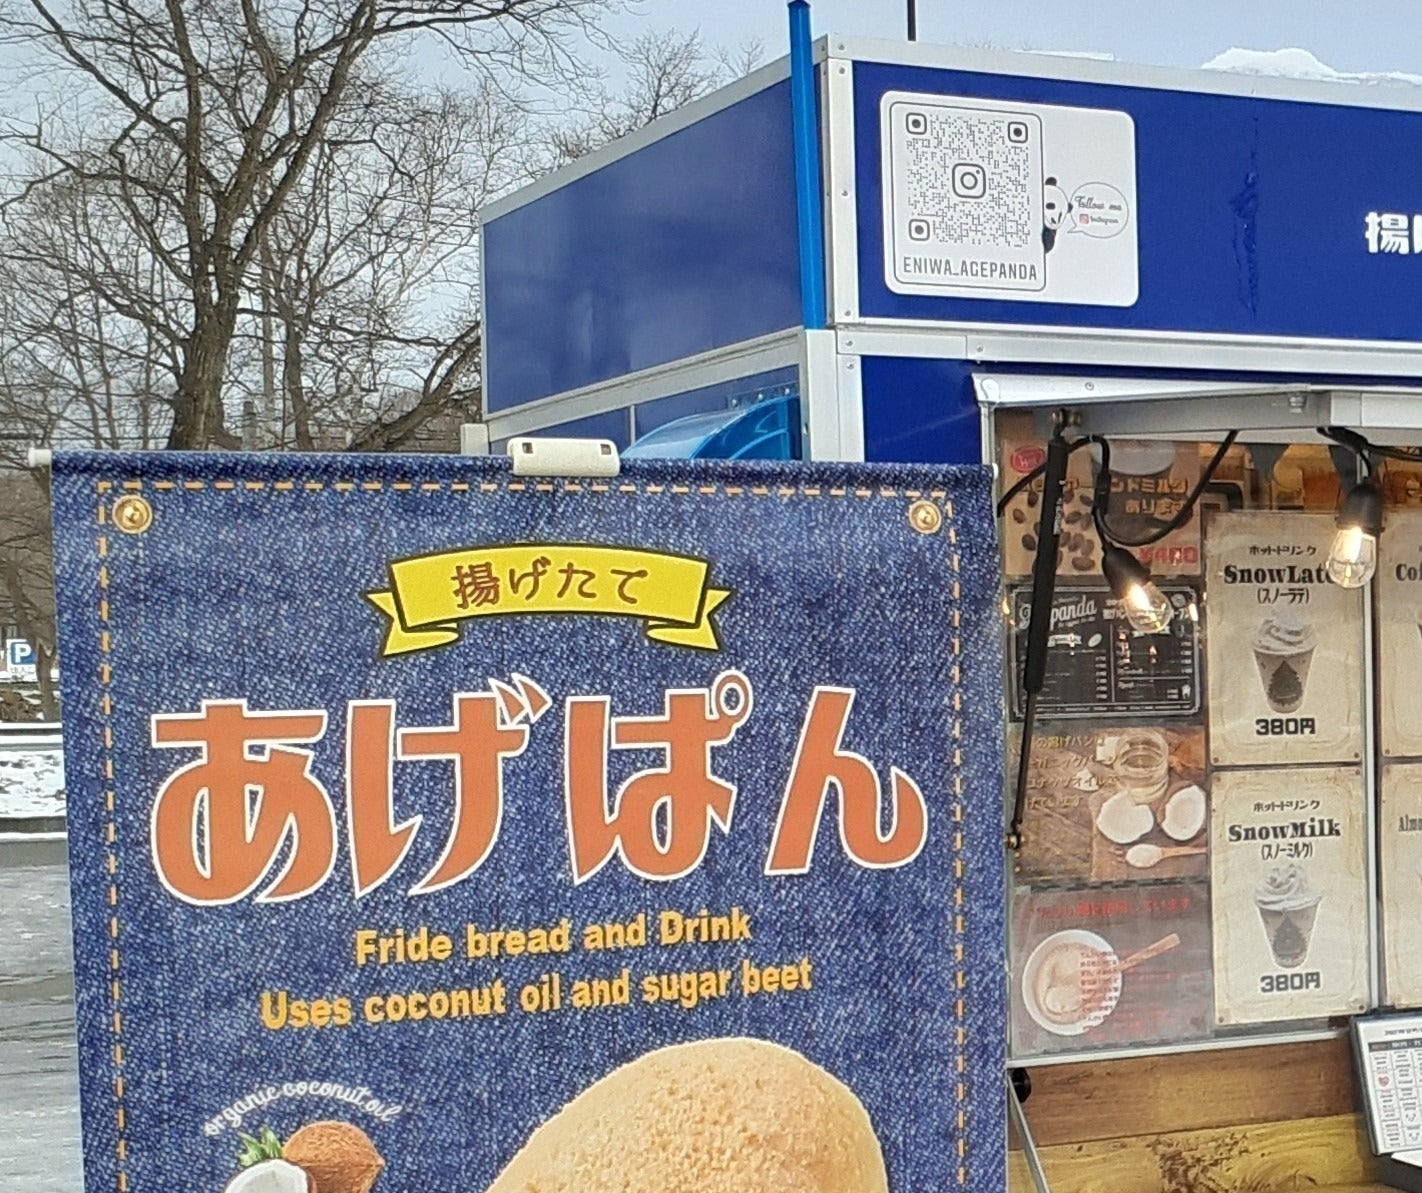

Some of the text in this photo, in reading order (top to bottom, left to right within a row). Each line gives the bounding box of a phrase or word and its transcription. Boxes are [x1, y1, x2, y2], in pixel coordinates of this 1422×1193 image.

[902, 256, 1038, 282] ENIWA_AGEPANDA
[452, 560, 648, 610] 揚げたて
[15, 643, 31, 663] P
[1255, 718, 1316, 736] 380円
[149, 668, 928, 907] あげぱん
[1228, 817, 1342, 842] SnowMilk
[354, 907, 752, 967] Fride bread and Drink
[260, 956, 814, 1031] Uses coconut oil and sugar beet
[1260, 971, 1321, 993] 380円
[283, 1080, 373, 1107] coconut
